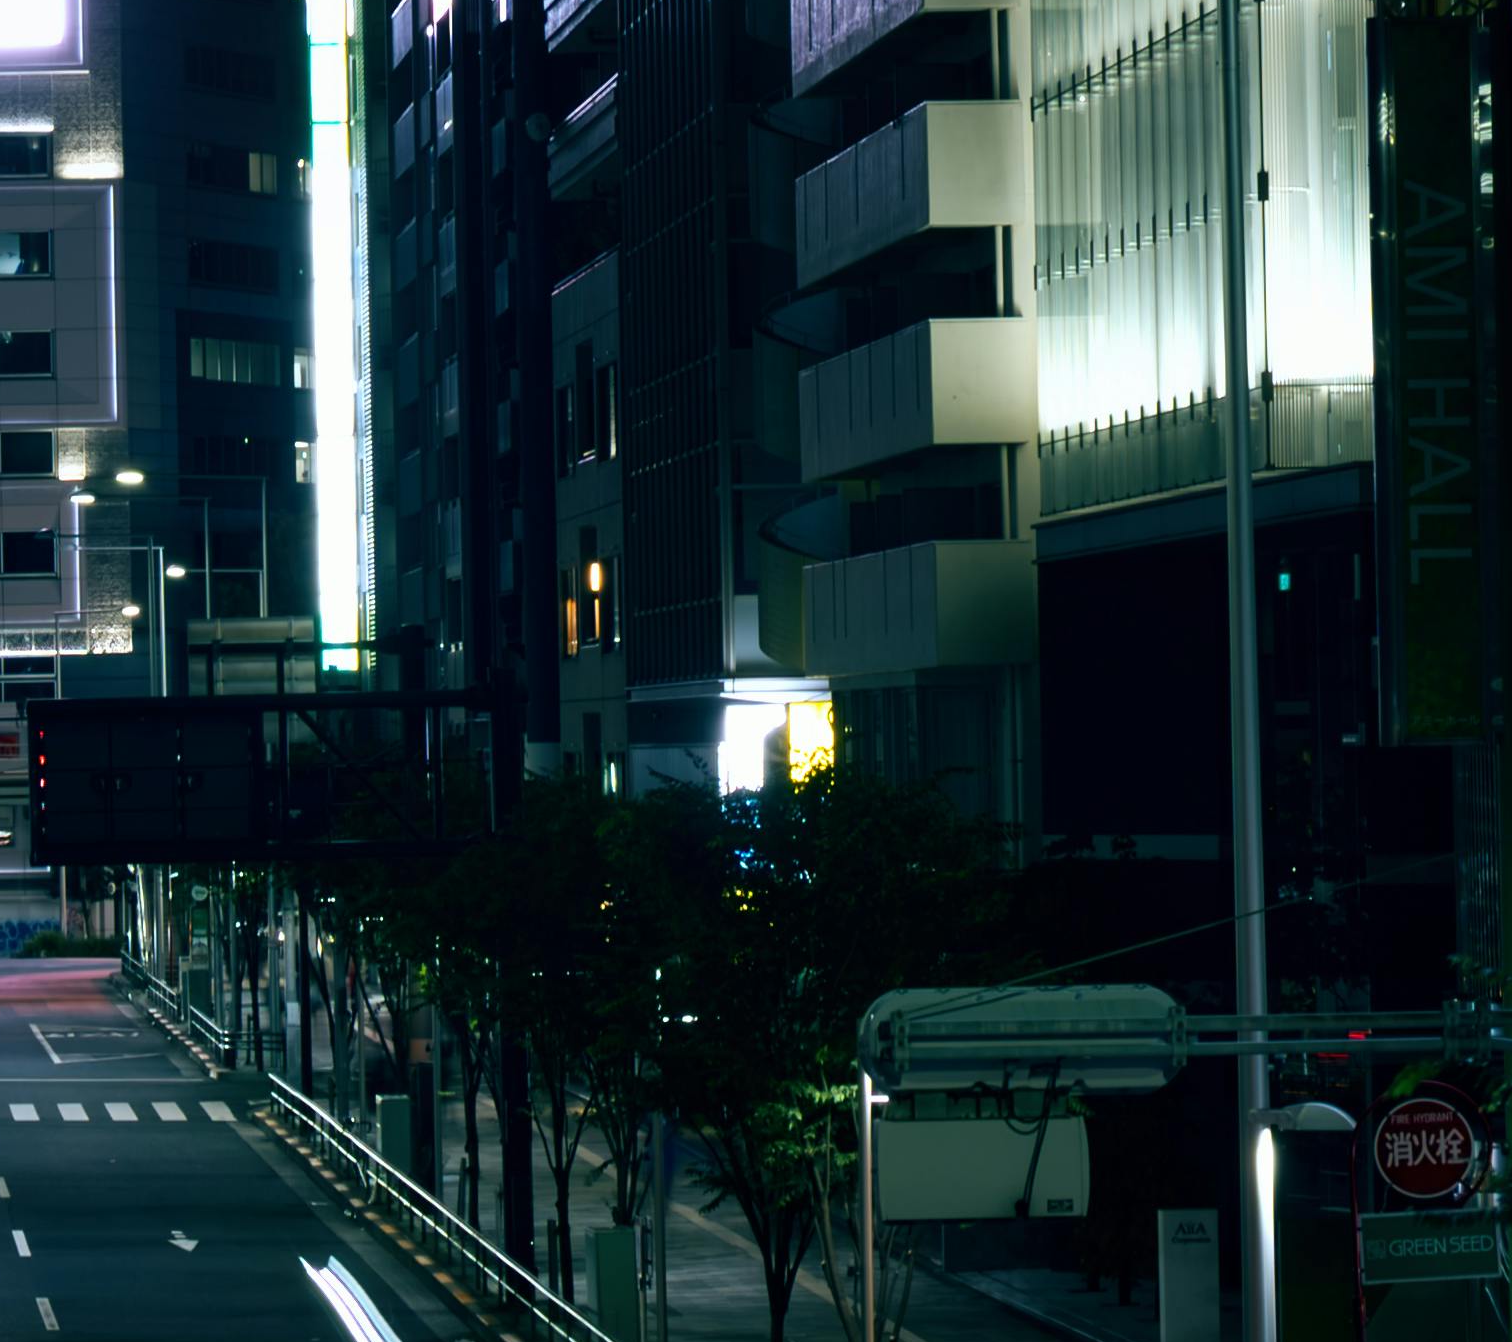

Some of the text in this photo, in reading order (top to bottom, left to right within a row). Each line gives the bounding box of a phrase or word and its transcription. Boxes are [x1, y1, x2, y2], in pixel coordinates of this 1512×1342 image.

[1407, 378, 1473, 586] HALL
[1391, 1111, 1454, 1125] FIRE HYDRANT
[1384, 1128, 1471, 1169] 消火栓
[1389, 1234, 1495, 1258] GREEN SEED
